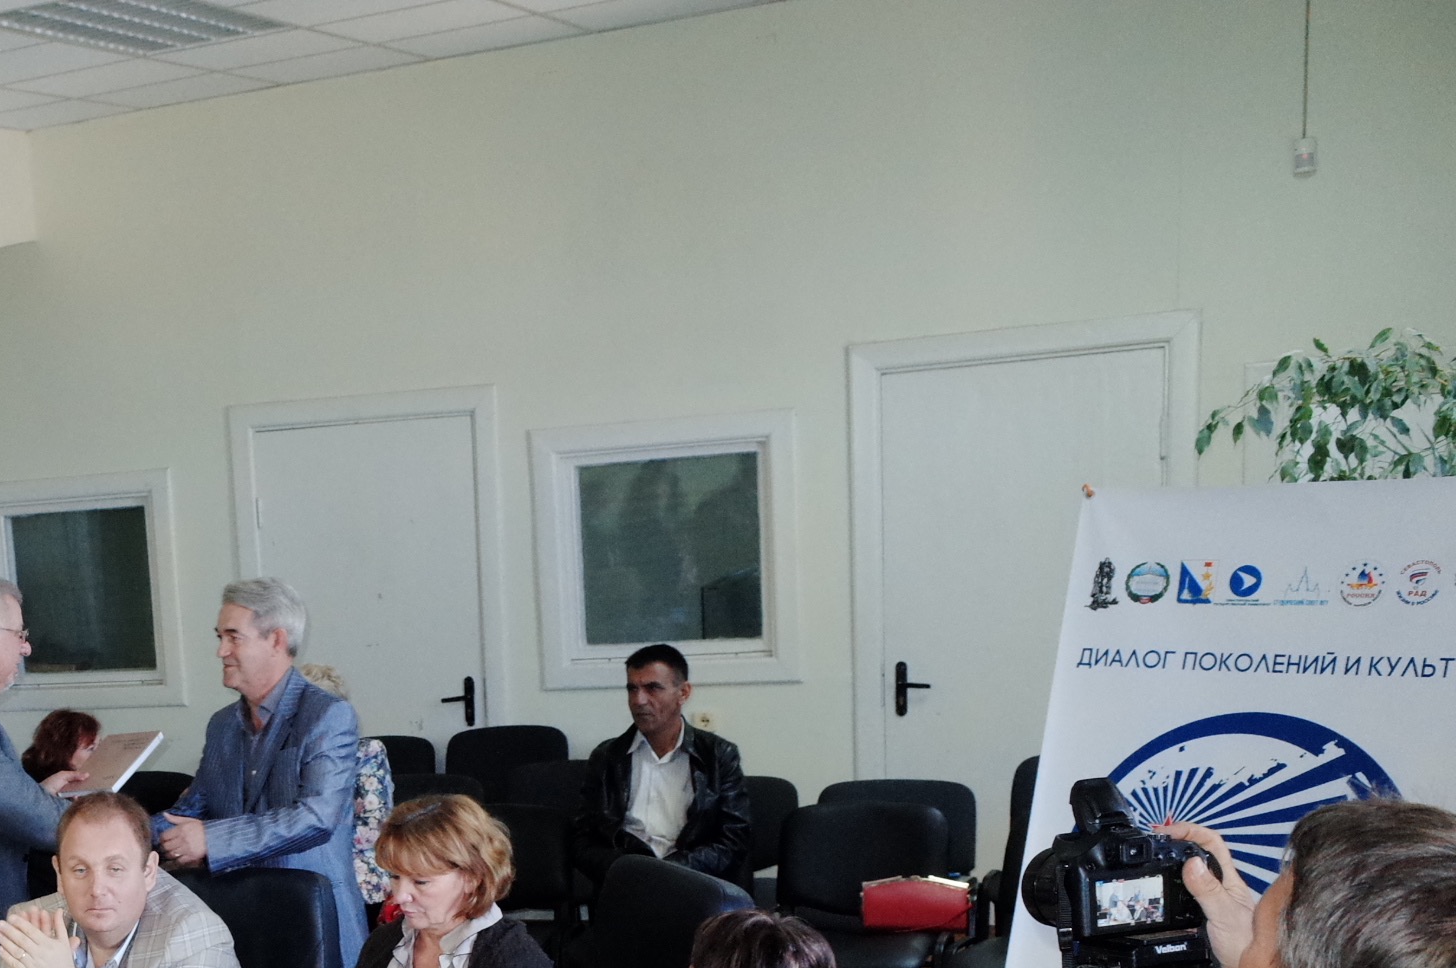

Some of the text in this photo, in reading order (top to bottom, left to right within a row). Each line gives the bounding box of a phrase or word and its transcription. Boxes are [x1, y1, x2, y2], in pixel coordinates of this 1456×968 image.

[1407, 590, 1428, 598] РАД
[1076, 647, 1456, 679] ДИАЛОГ ПОКОЛЕНИЙ И КУЛЬТ
[1154, 944, 1187, 955] Velbon
